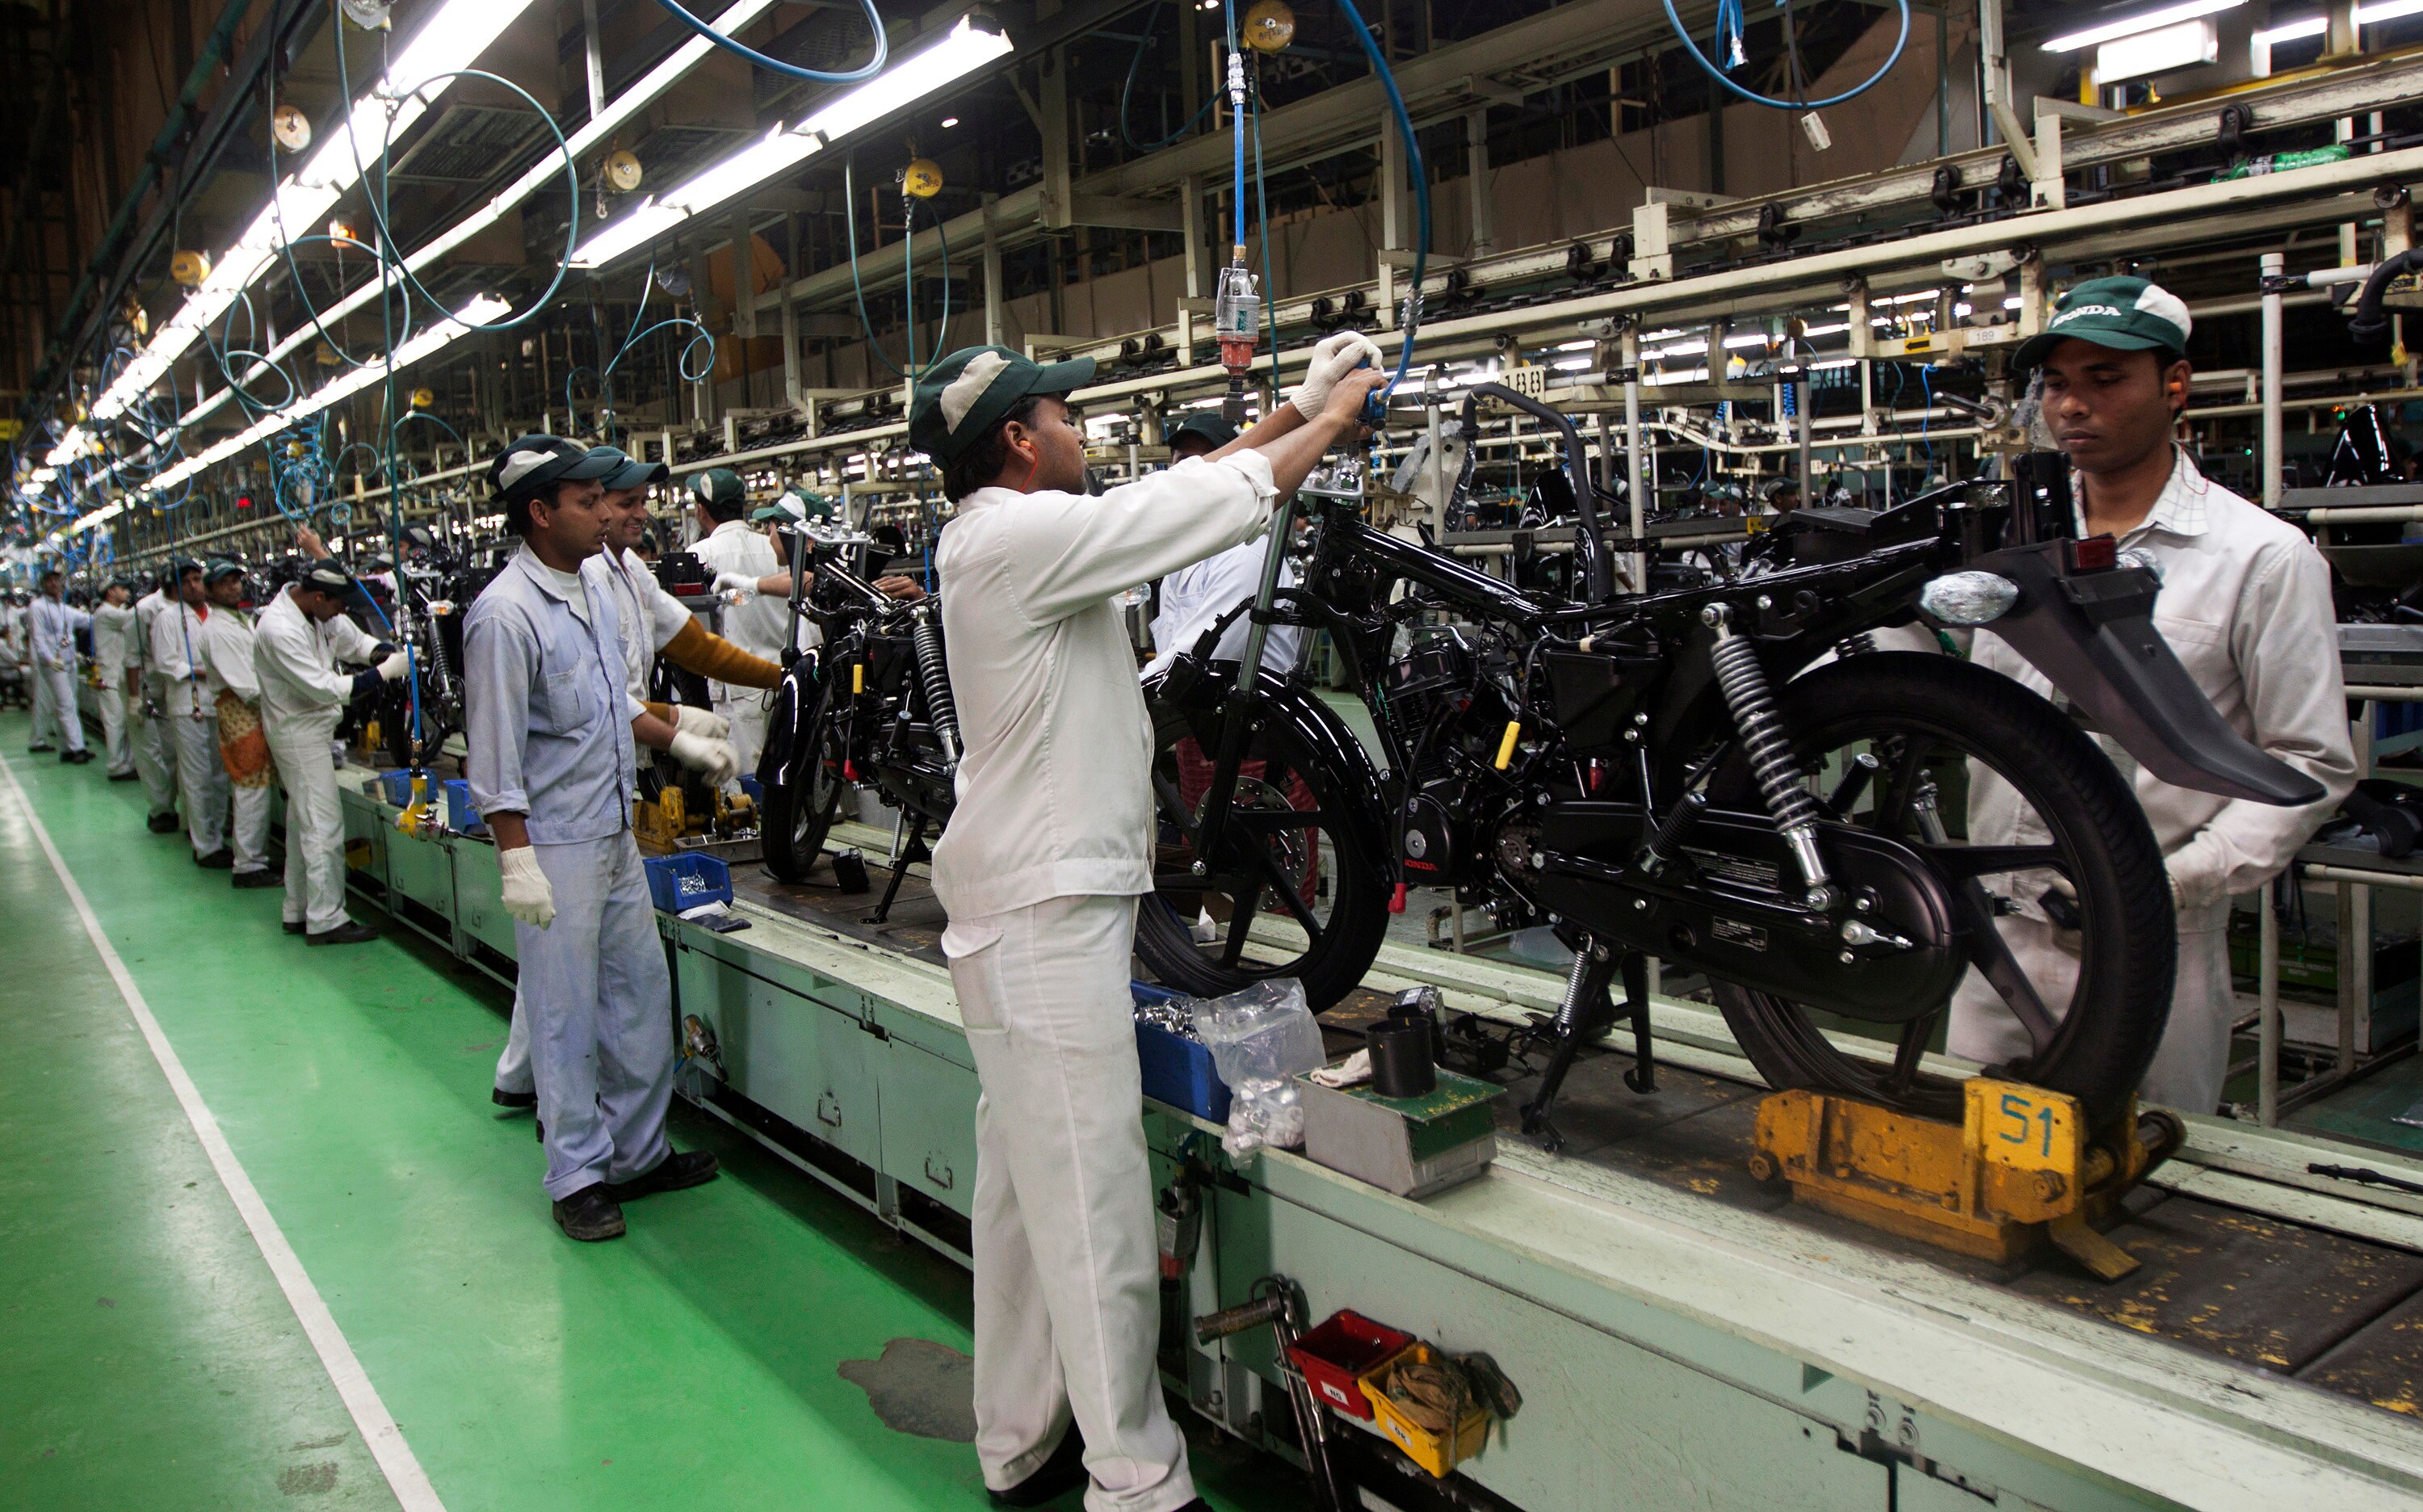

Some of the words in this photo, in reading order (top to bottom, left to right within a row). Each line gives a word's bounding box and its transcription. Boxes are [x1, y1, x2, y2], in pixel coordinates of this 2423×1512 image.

[2052, 304, 2122, 328] HONDA
[1976, 330, 1994, 341] 189
[1505, 371, 1540, 394] 188
[1329, 1388, 1343, 1402] NG
